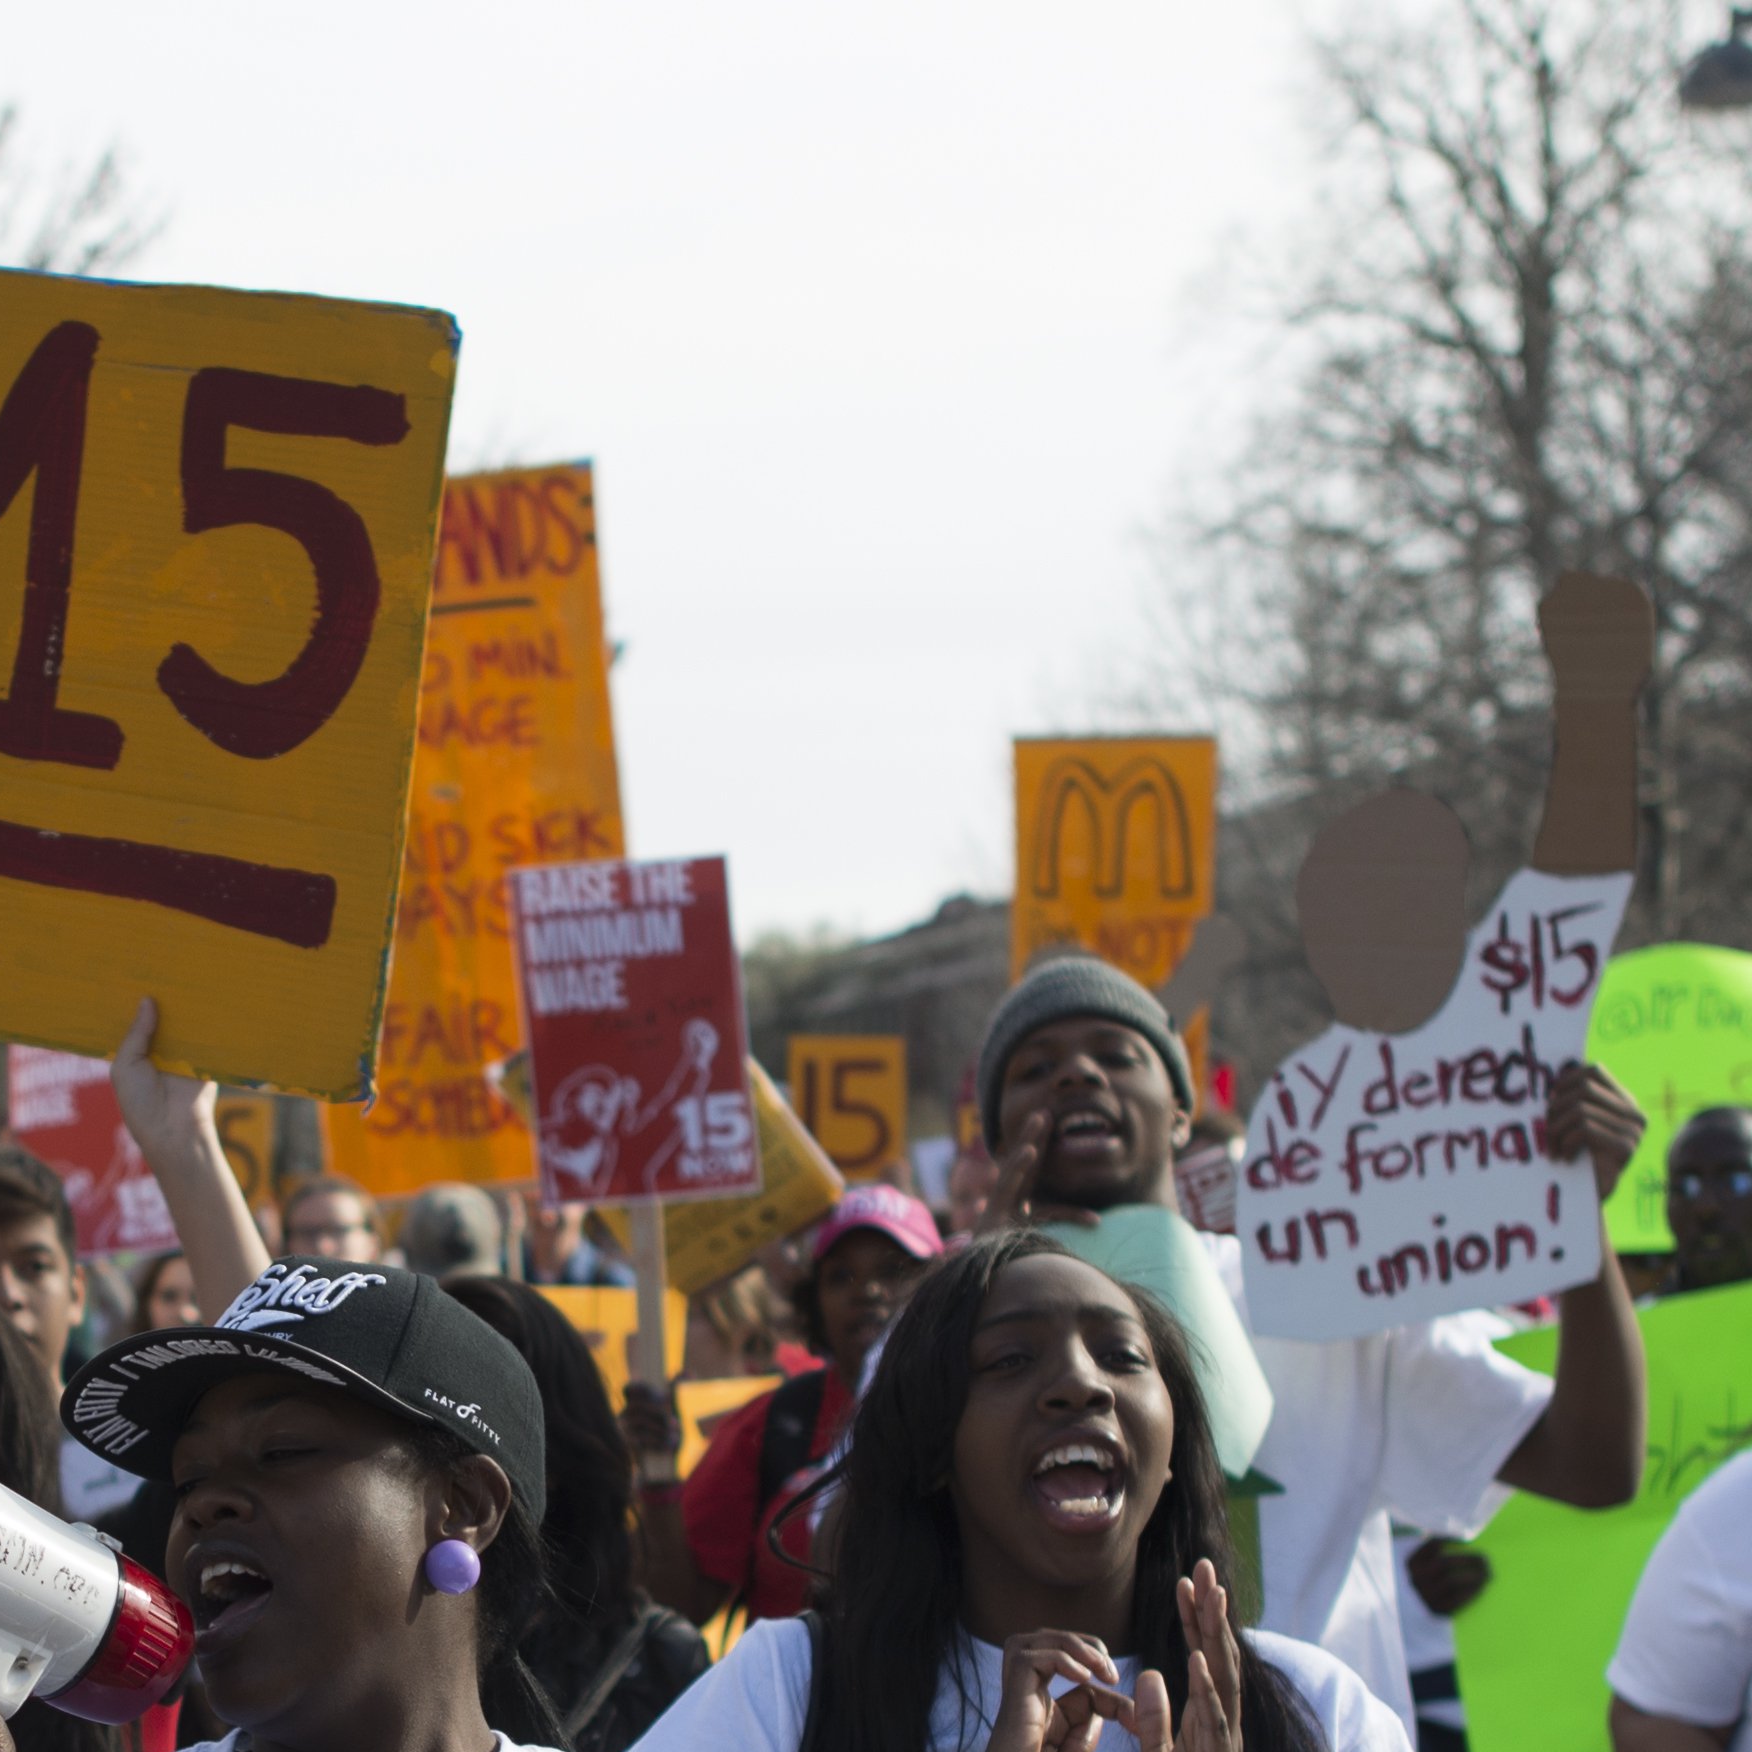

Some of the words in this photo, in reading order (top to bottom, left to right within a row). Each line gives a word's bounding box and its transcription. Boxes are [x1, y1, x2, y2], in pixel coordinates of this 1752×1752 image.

[515, 866, 622, 914] RAISE
[627, 861, 696, 908] THE
[523, 908, 685, 964] MINIMUM
[1480, 901, 1606, 1015] $15
[530, 962, 630, 1017] WAGE
[673, 1091, 749, 1154] 15
[803, 1056, 891, 1170] 15
[679, 1149, 751, 1184] NOW
[1246, 1117, 1324, 1190] de
[1256, 1208, 1359, 1264] un
[424, 1387, 456, 1409] FLAT
[471, 1414, 501, 1446] FITTY
